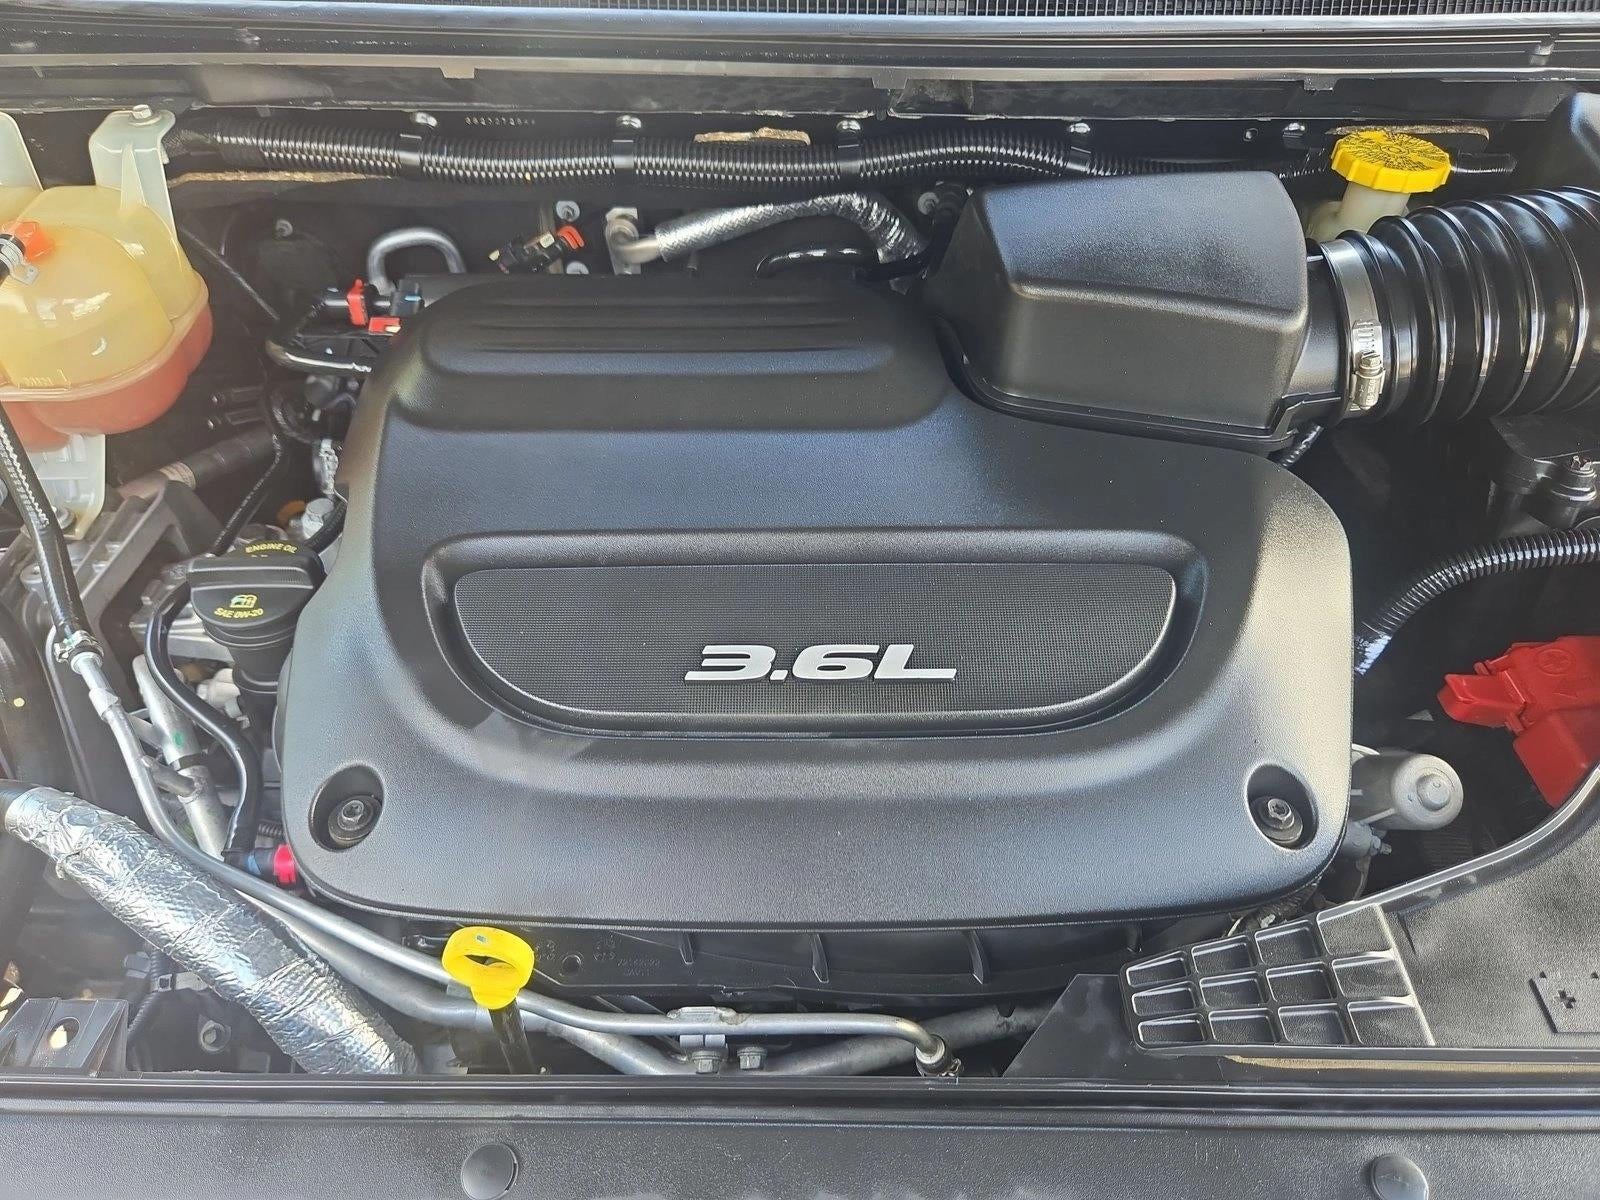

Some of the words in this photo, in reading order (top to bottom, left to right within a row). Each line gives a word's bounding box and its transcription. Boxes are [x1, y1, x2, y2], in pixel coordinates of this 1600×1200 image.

[245, 542, 284, 553] ENGINE
[283, 544, 298, 554] OIL
[214, 607, 235, 618] SAE
[685, 644, 957, 682] 3.6L
